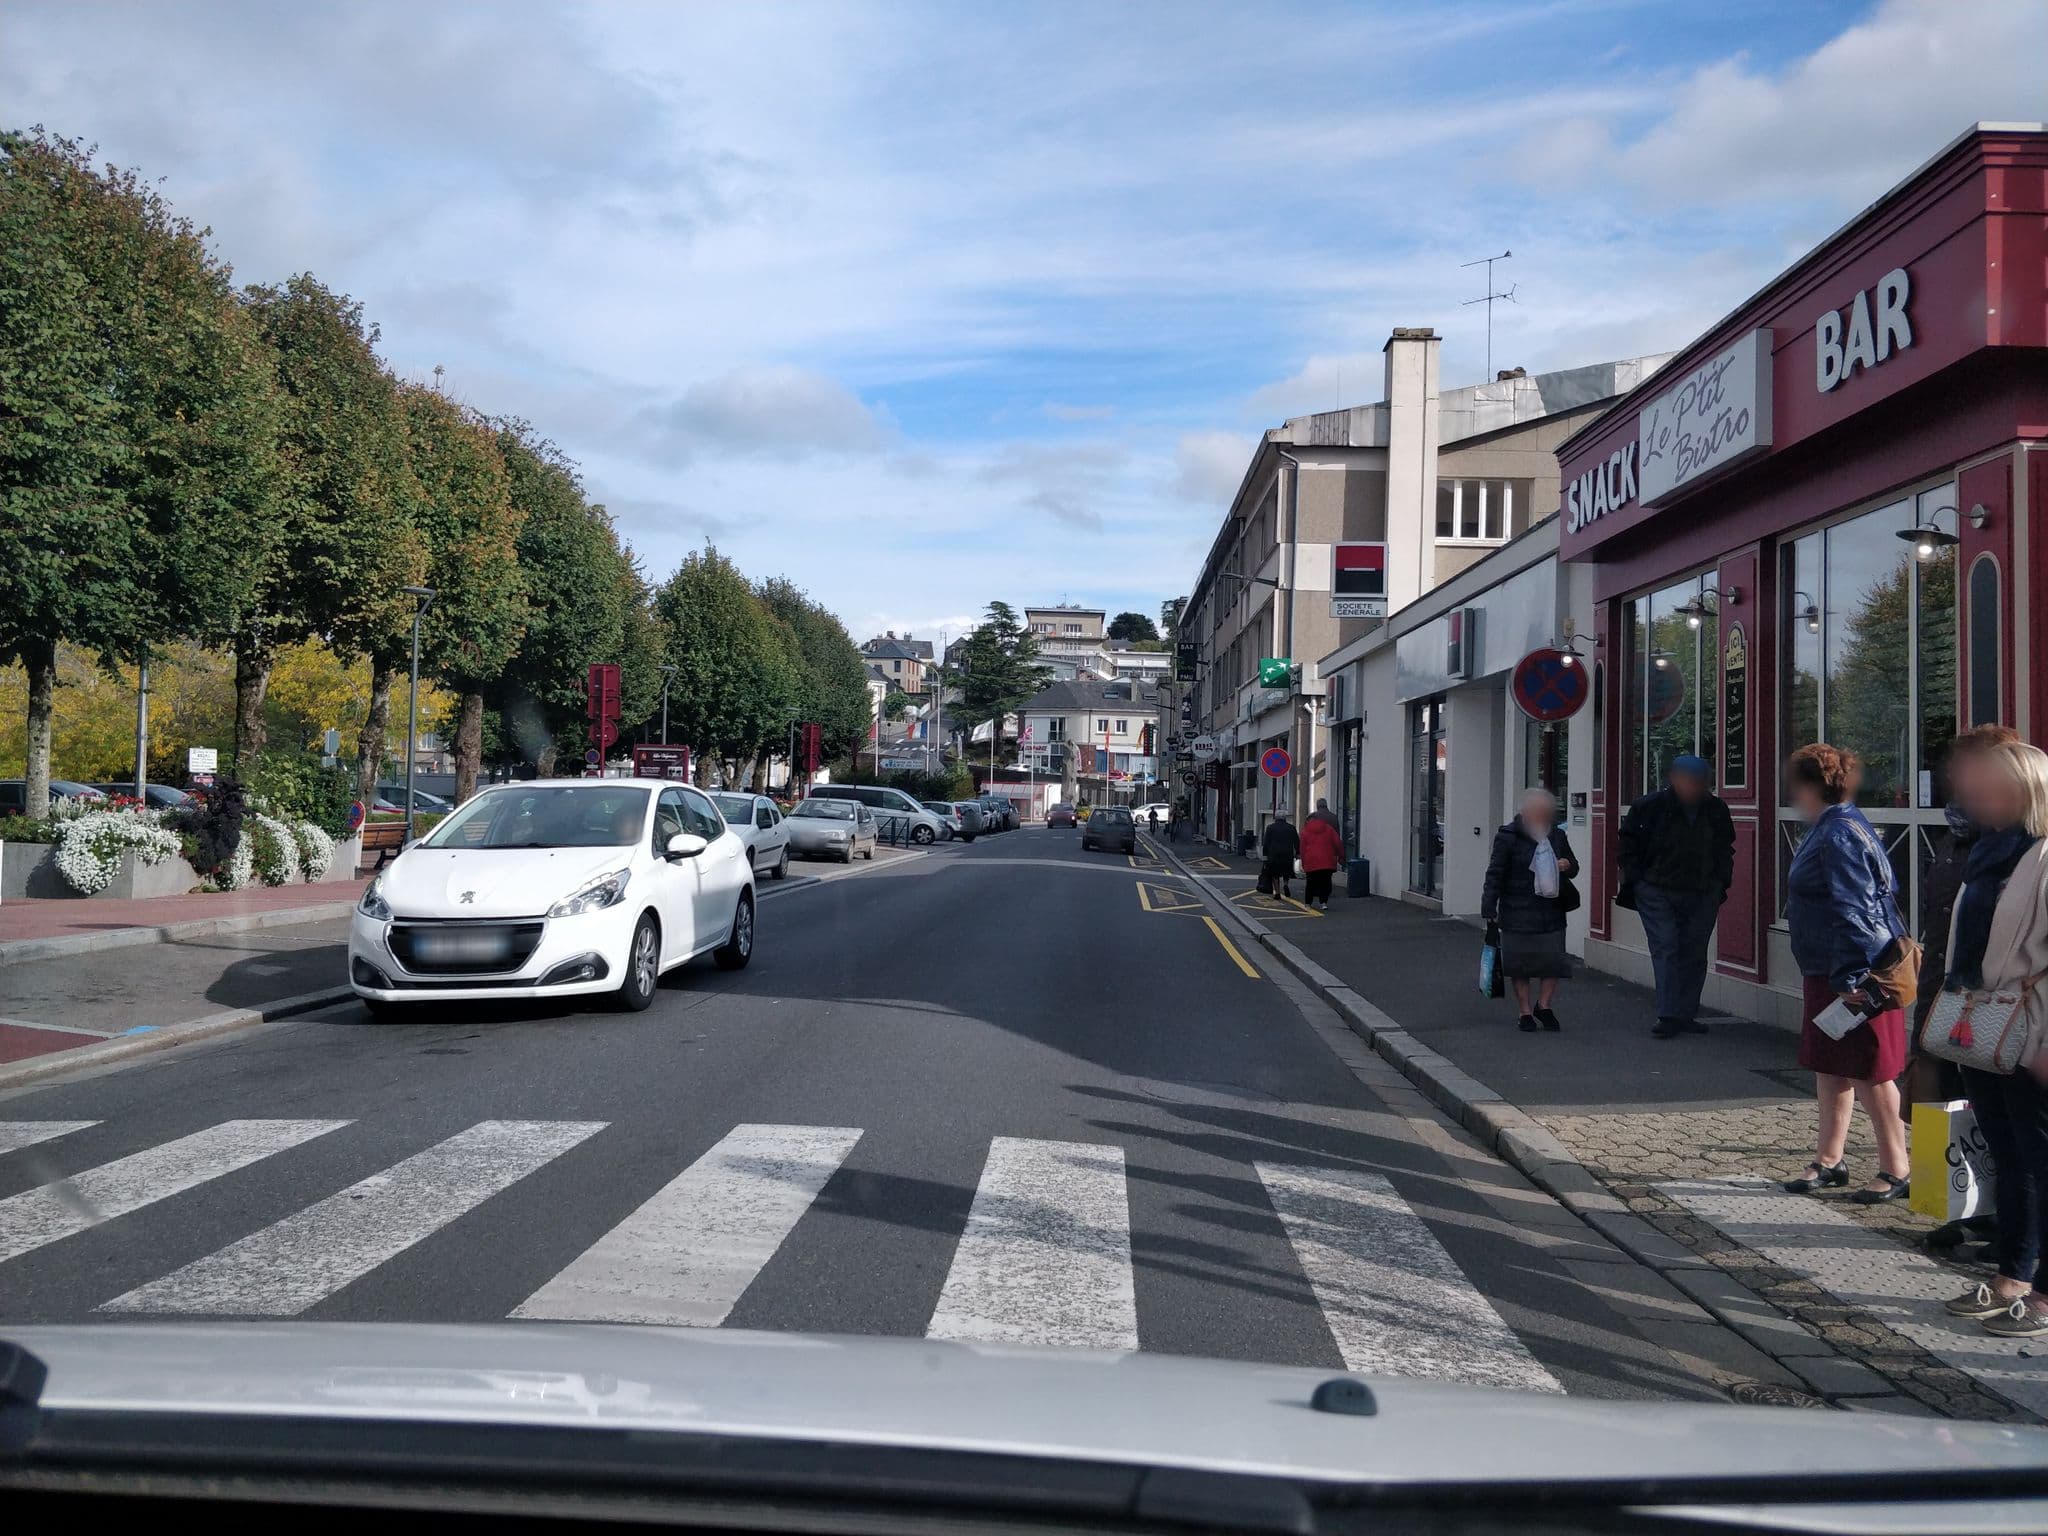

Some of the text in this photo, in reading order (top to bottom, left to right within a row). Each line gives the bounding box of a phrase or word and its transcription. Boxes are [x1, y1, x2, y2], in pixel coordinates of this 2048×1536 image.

[1816, 267, 1912, 393] BAR
[1642, 408, 1672, 468] Le
[1671, 406, 1750, 483] Bistro
[1566, 440, 1636, 535] SNACK
